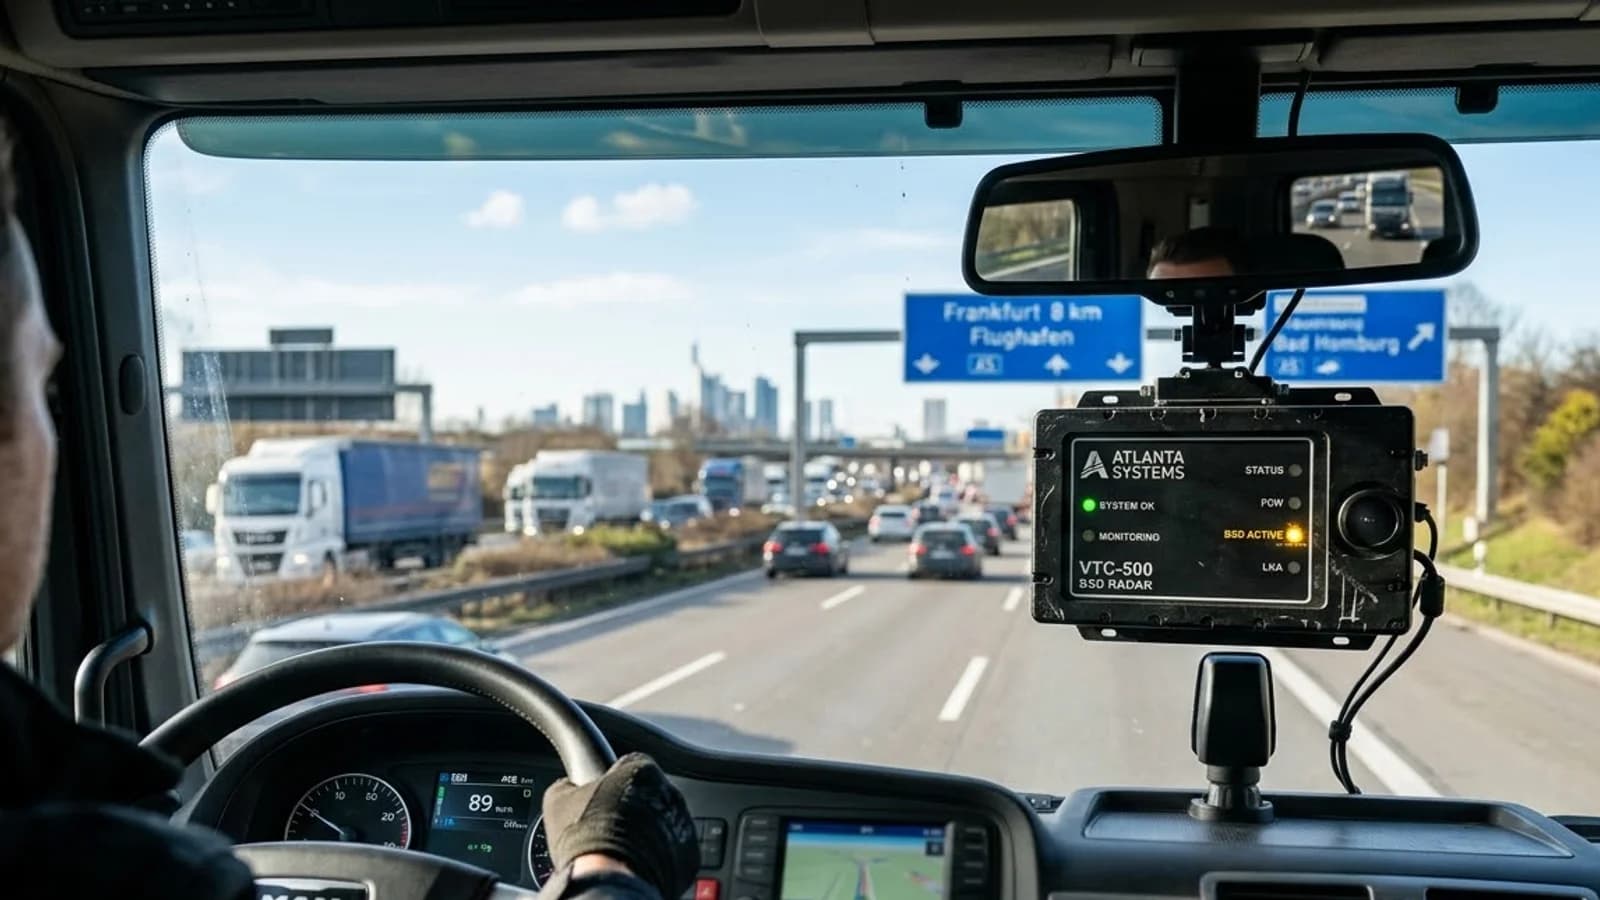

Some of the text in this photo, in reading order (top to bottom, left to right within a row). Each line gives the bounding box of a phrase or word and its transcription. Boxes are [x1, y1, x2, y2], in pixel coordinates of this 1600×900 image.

[943, 302, 1041, 321] Frankfurt
[1069, 302, 1103, 321] km
[970, 326, 1075, 350] Flughafen
[1112, 450, 1185, 464] ATLANTA
[1112, 465, 1185, 480] SYSTEMS
[1245, 465, 1284, 475] STATUS
[1099, 500, 1155, 511] SYSTEM OK
[1246, 530, 1284, 540] ACTIVE
[1079, 560, 1153, 577] VTC-500
[1262, 562, 1284, 572] LKA
[1107, 578, 1153, 591] RADAR
[335, 791, 346, 801] 10
[468, 793, 493, 812] 89
[381, 812, 395, 822] 20
